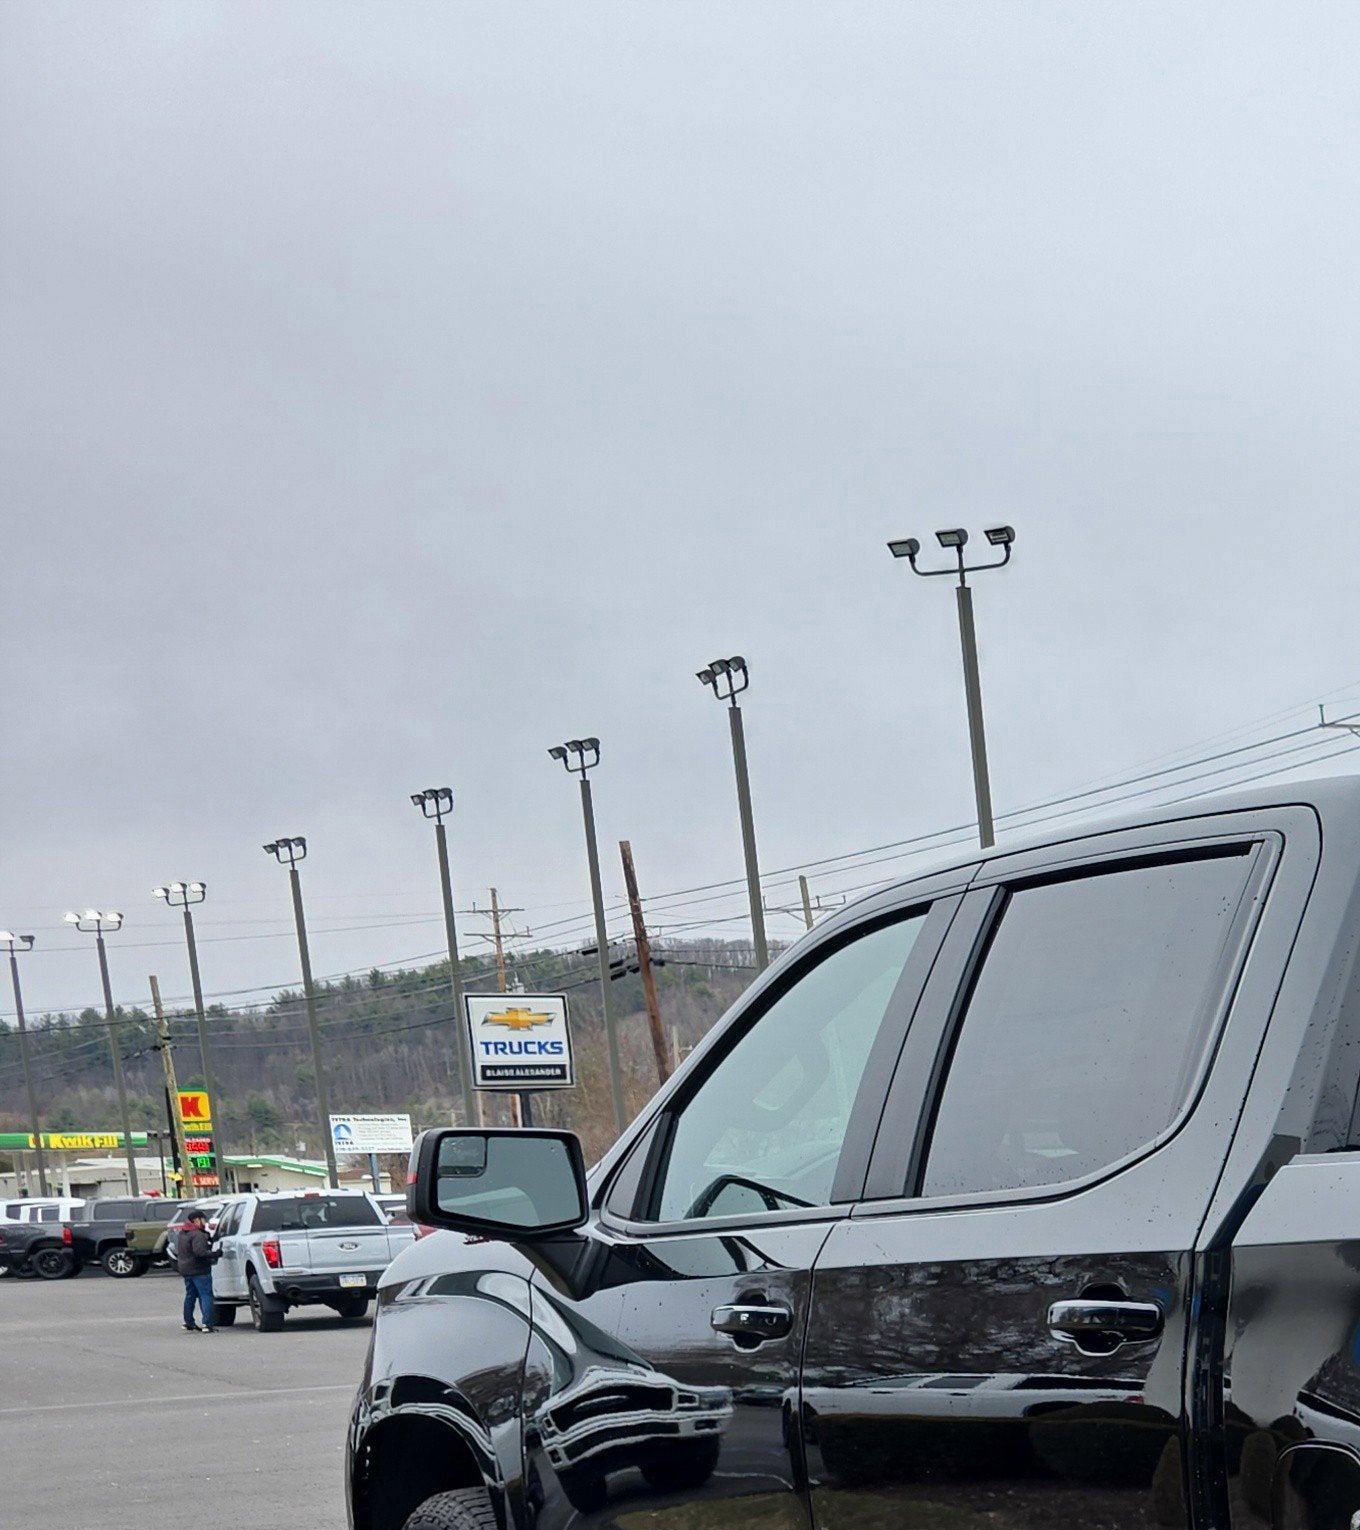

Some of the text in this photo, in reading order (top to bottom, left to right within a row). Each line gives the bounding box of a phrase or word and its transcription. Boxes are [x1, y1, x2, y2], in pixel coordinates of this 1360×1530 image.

[480, 1041, 564, 1055] TRUCKS
[180, 1096, 204, 1118] K
[48, 1133, 119, 1149] Kwik Fill
